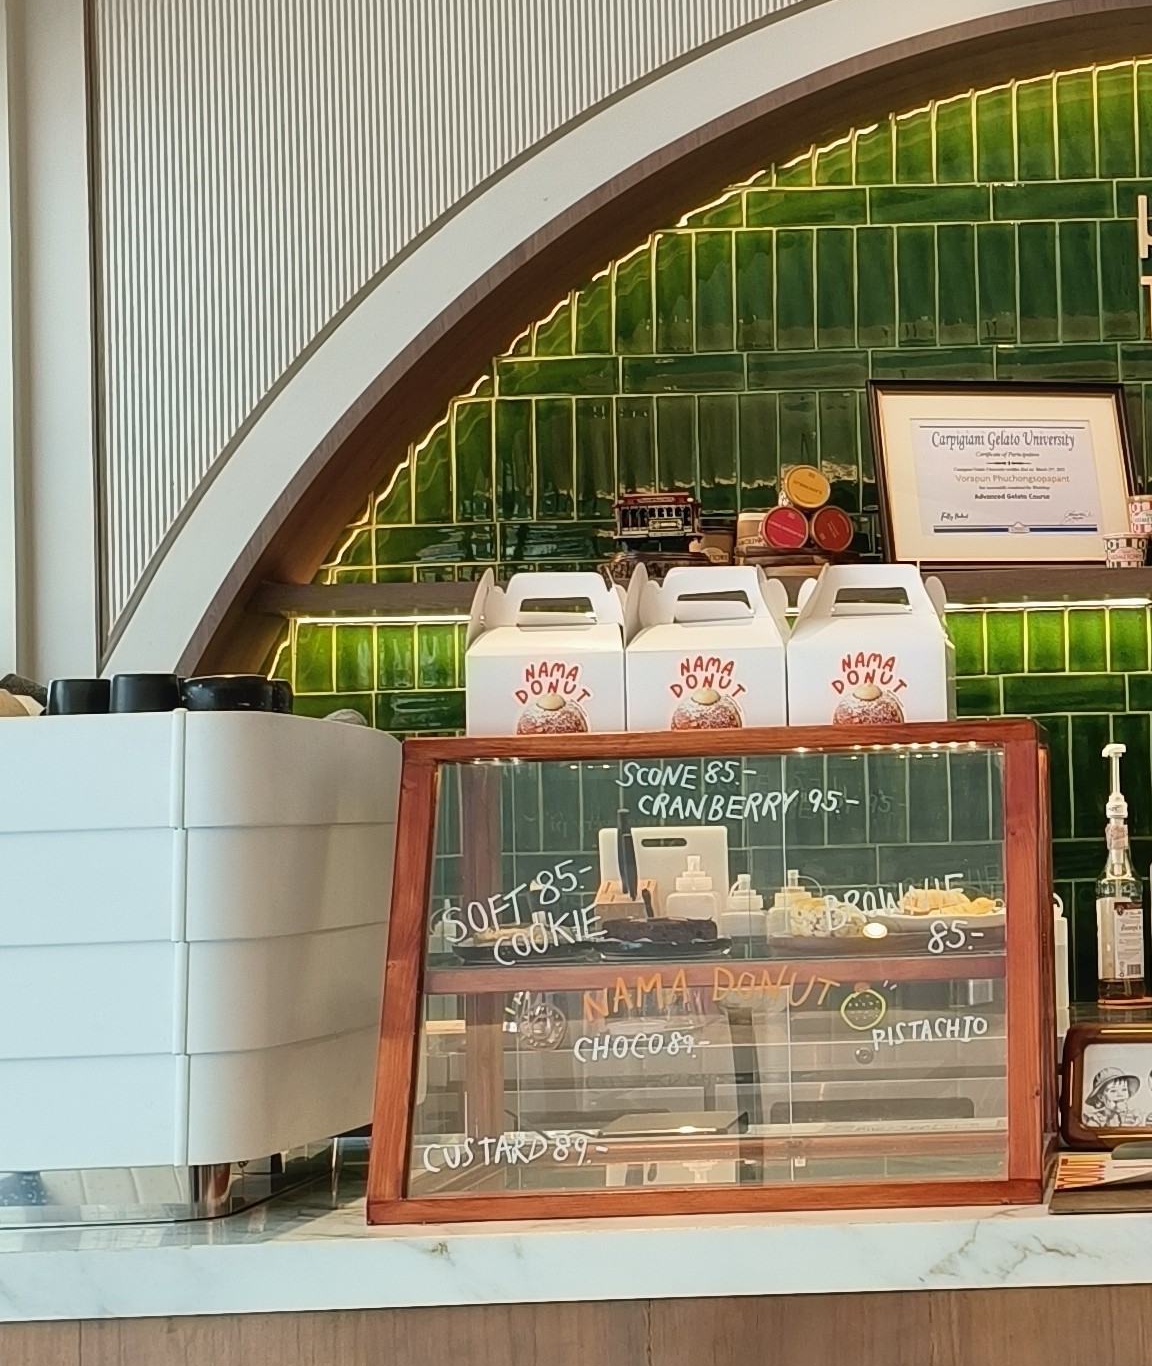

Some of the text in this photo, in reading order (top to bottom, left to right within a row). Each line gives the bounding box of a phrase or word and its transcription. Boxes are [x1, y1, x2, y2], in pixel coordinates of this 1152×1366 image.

[931, 430, 1075, 451] Carpigiani Gelato University
[525, 661, 579, 683] NAMA
[680, 656, 735, 677] NAMA
[841, 651, 896, 673] NAMA
[515, 679, 591, 704] DONUT
[670, 673, 746, 698] DONUT
[831, 668, 908, 695] DONUT
[615, 761, 698, 789] SCONE
[638, 790, 799, 822] CRANBERRY
[441, 883, 528, 943] SOFT
[823, 873, 964, 932] BROWNIE
[493, 905, 608, 966] COOKIE
[583, 966, 840, 1022] NAMA DONUT
[574, 1032, 663, 1062] CHOCO
[872, 1015, 988, 1051] PISTACHIO
[423, 1136, 548, 1173] CUSTARD
